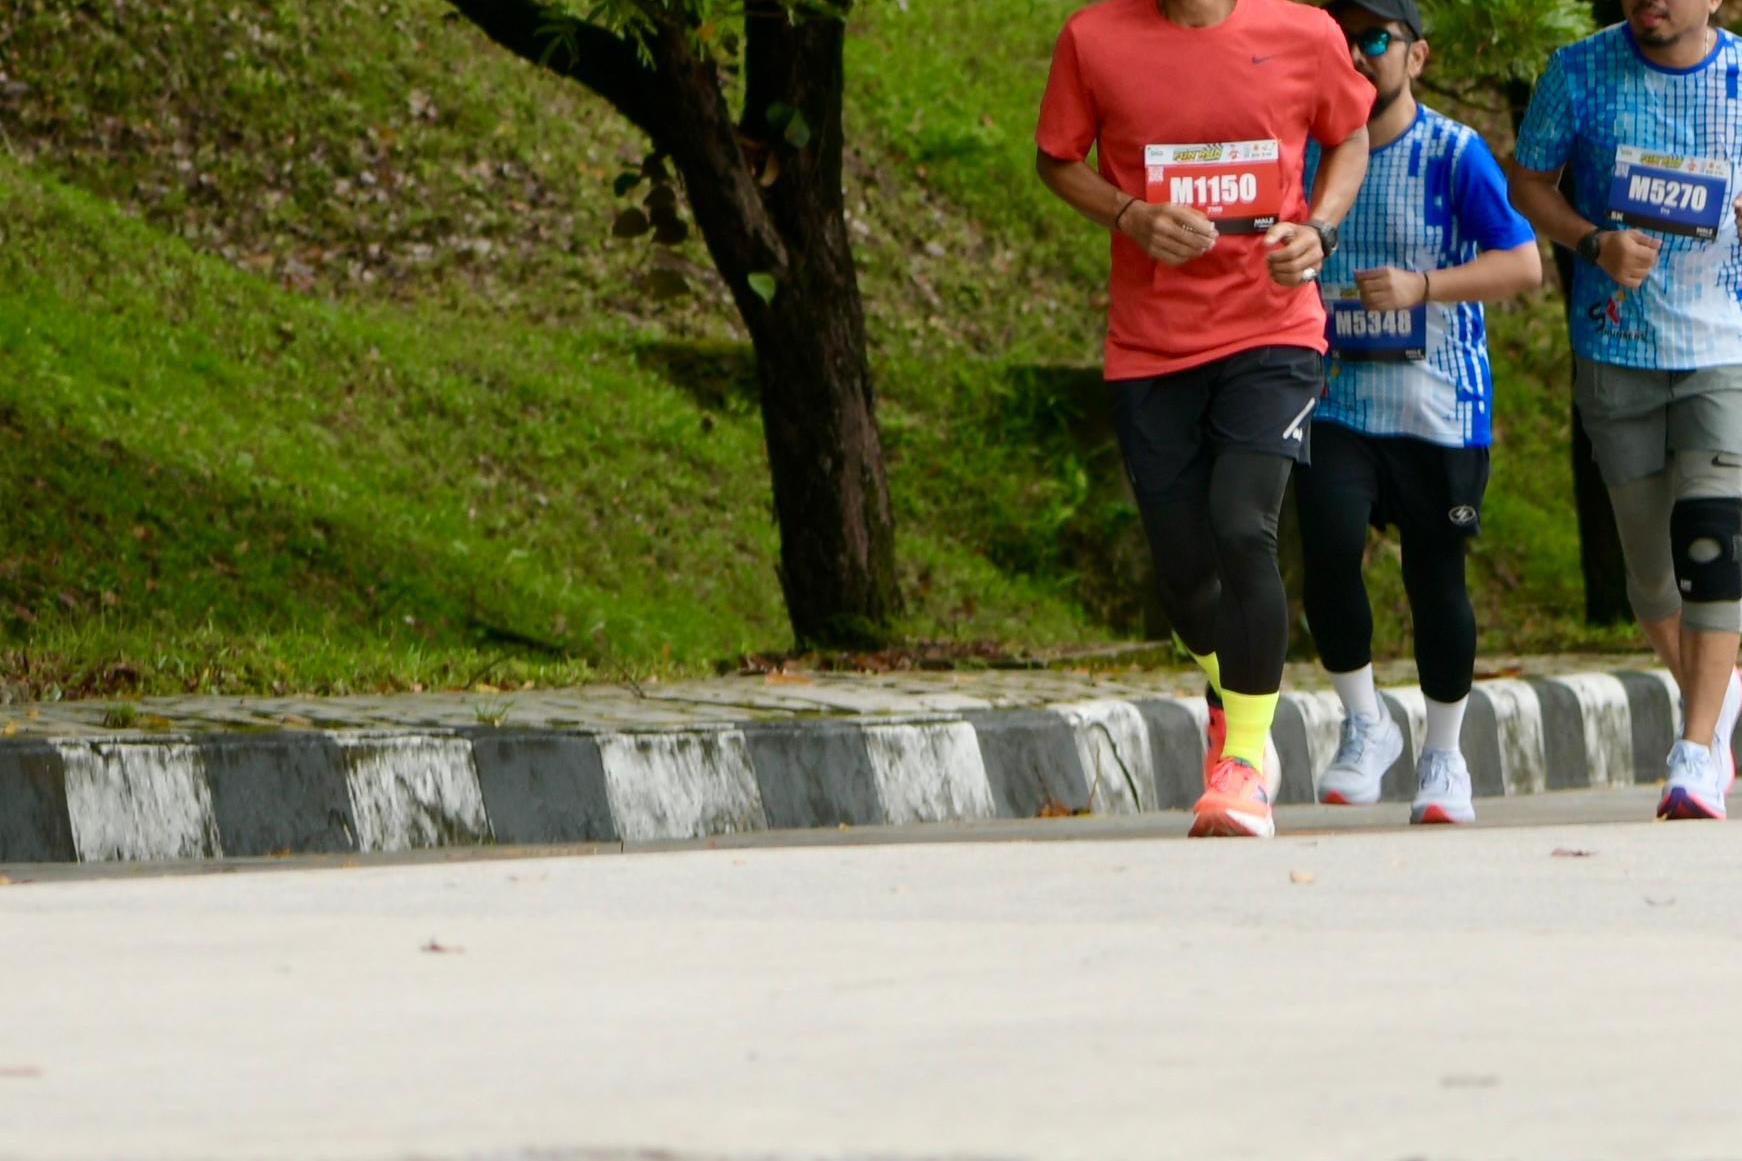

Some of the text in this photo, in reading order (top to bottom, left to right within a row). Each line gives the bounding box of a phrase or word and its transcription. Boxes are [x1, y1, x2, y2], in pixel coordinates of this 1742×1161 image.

[1170, 173, 1257, 206] M1150
[1628, 174, 1707, 213] M5270
[1254, 217, 1274, 225] MALE
[1335, 310, 1412, 338] M5348
